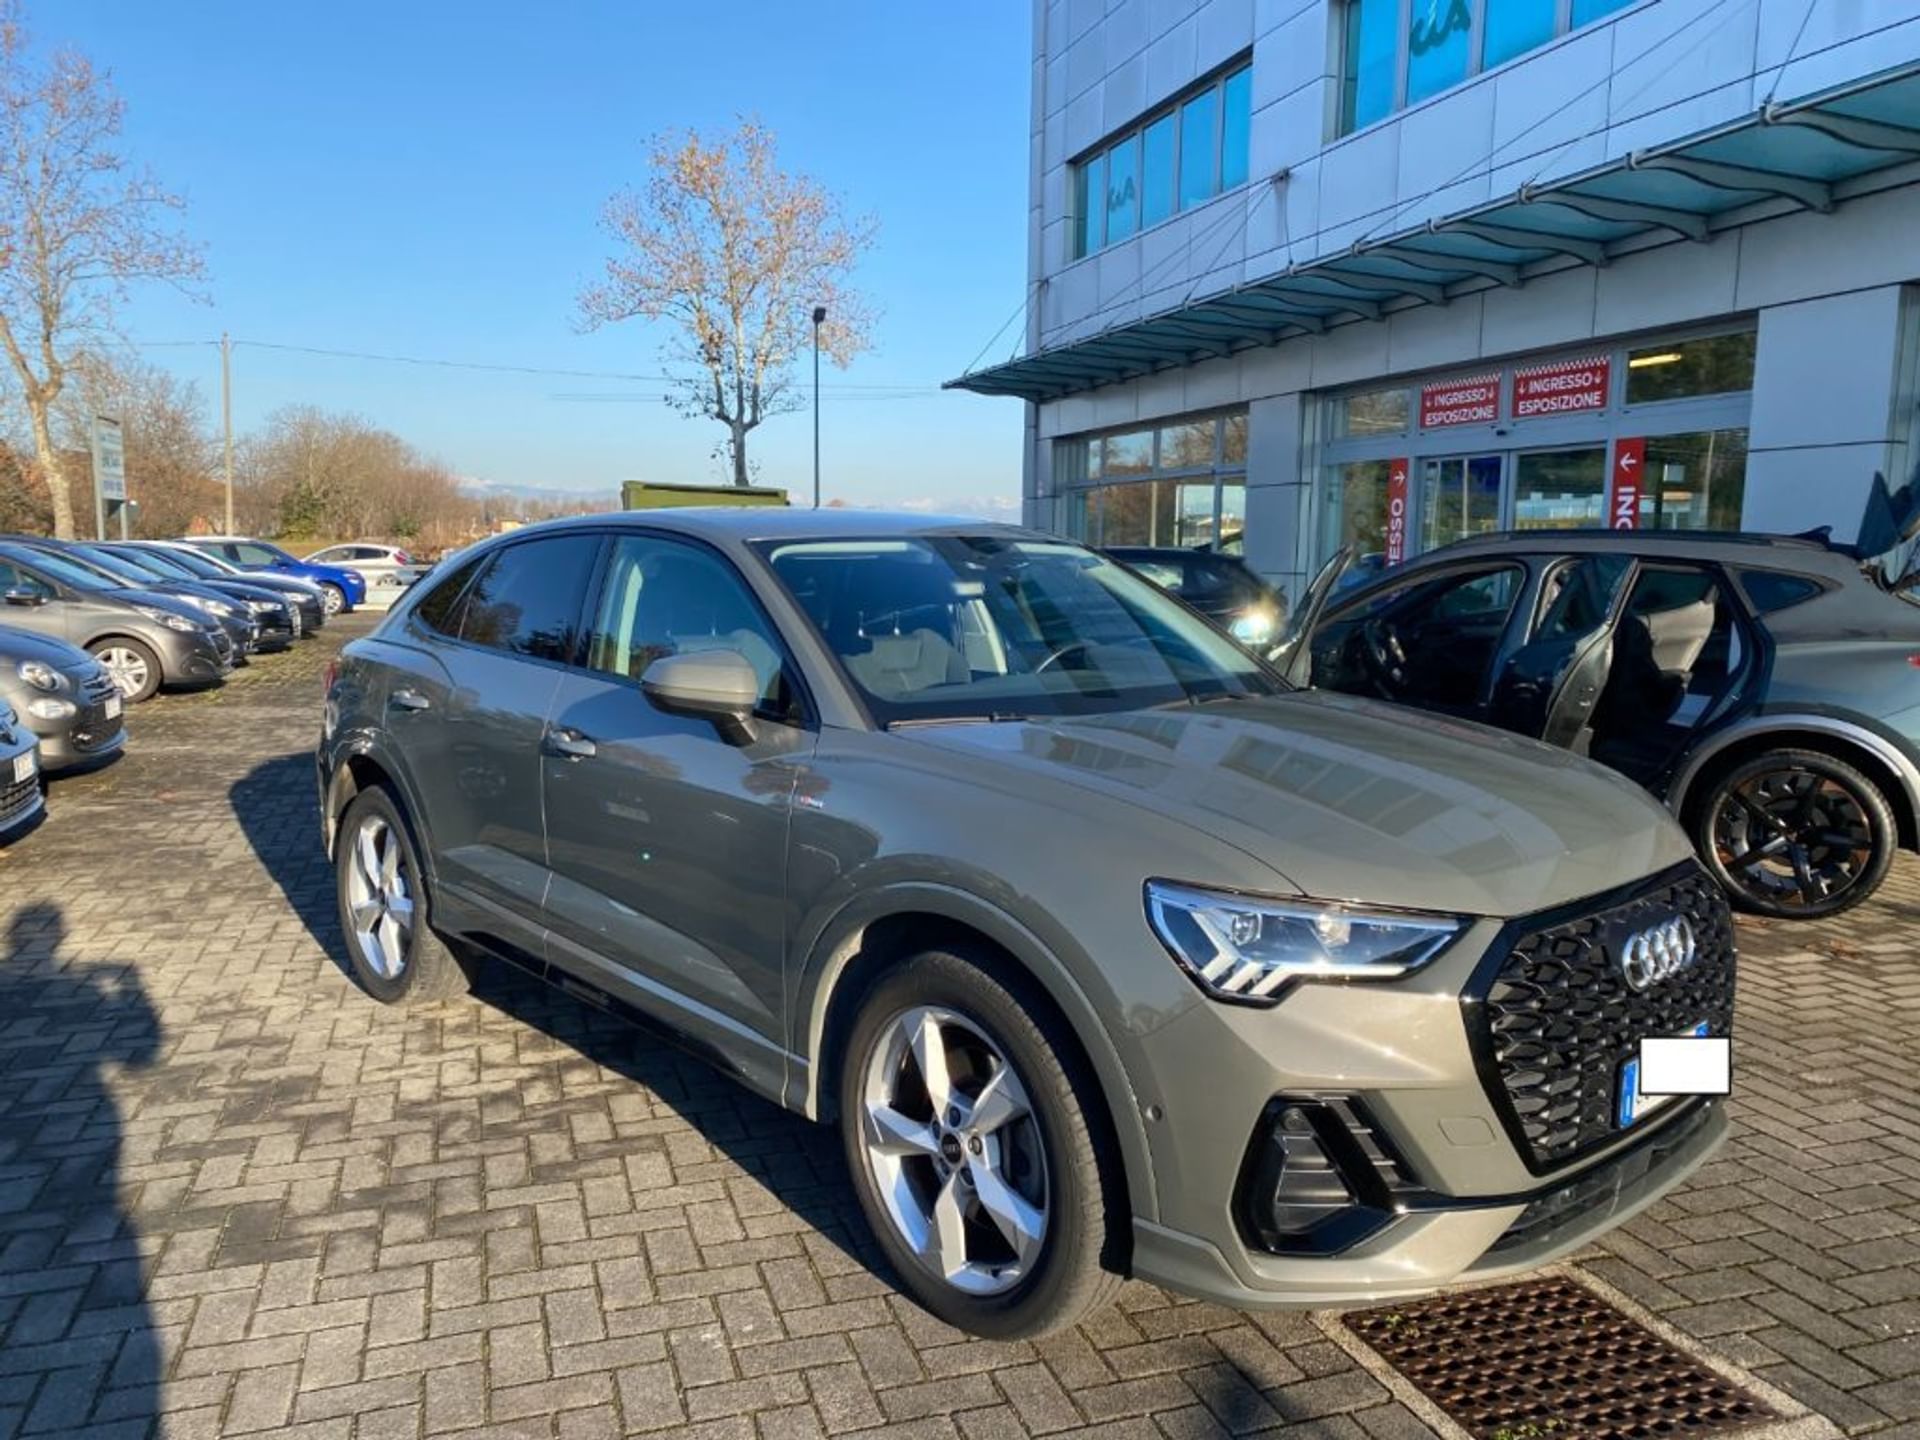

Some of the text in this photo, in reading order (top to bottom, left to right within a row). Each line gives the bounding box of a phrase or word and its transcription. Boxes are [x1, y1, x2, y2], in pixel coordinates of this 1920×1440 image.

[1529, 372, 1593, 393] INGRESSO
[1434, 388, 1486, 407] INGRESSO
[1518, 391, 1602, 414] ESPOSIZIONE
[1425, 405, 1495, 426] ESPOSIZIONE
